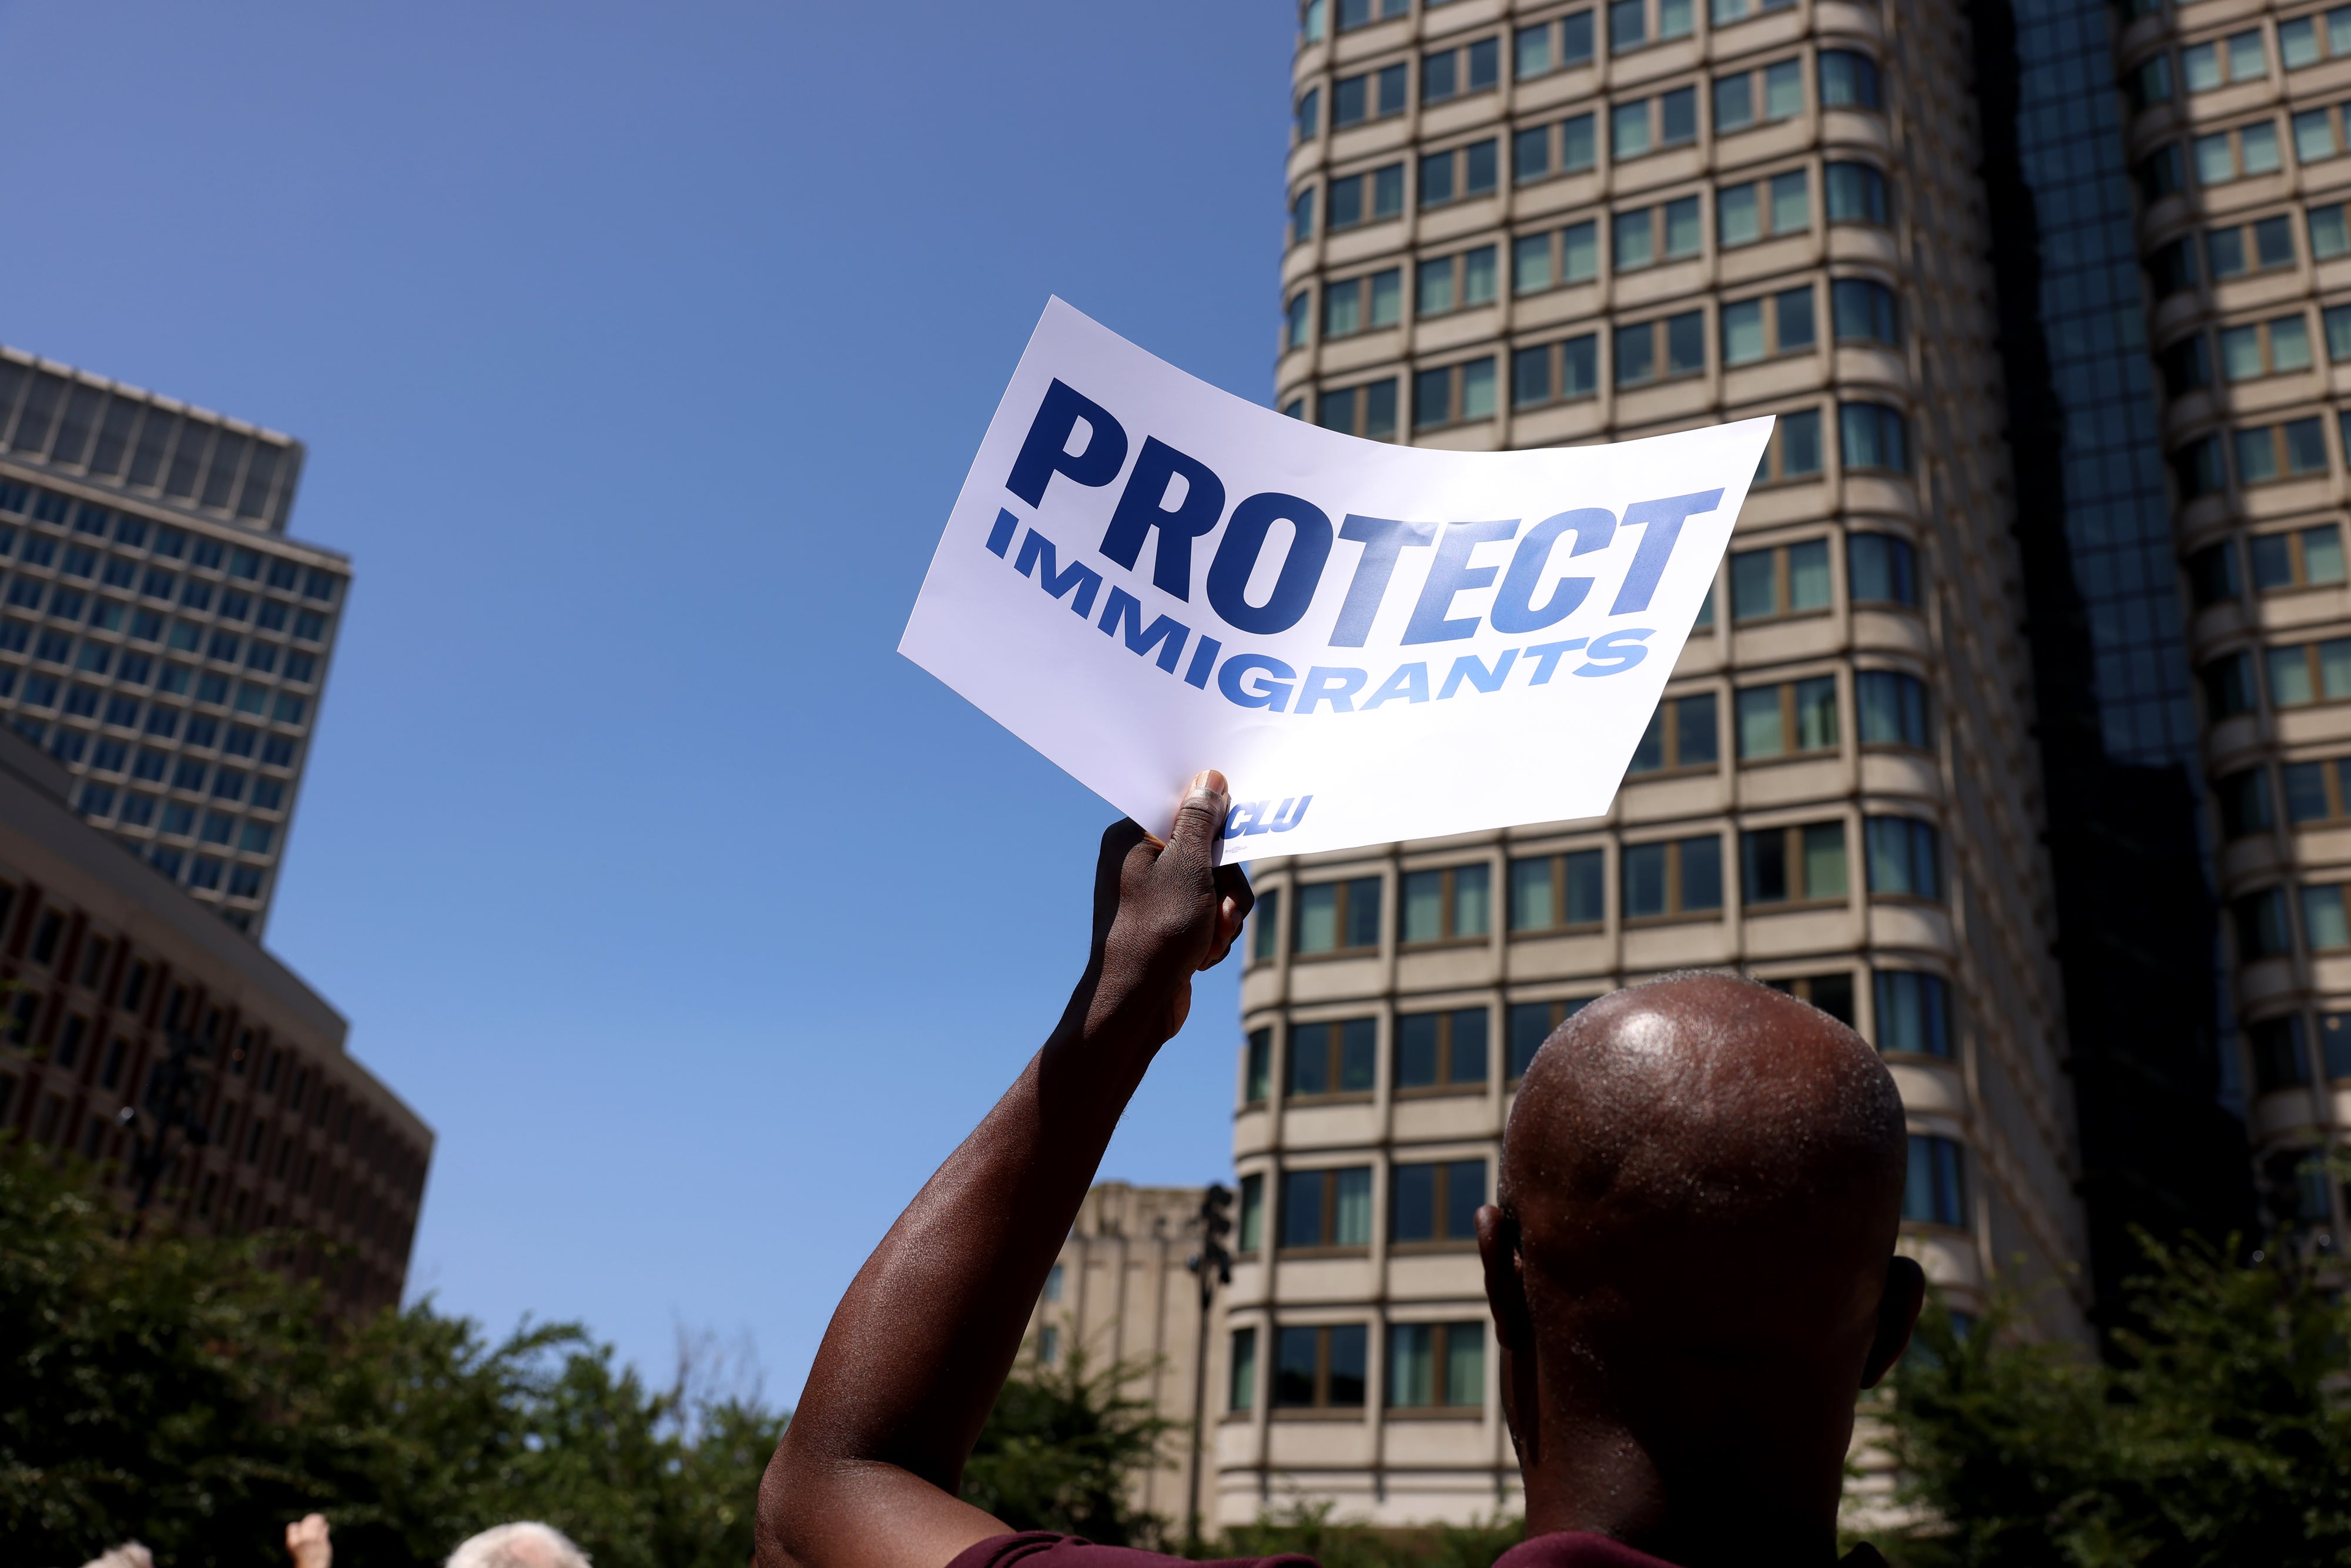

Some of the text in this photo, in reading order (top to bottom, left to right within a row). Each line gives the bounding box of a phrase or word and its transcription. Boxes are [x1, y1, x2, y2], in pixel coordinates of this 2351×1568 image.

[985, 508, 1657, 714] IMMIGRANTS
[1005, 377, 1726, 648] PROTECT
[1214, 795, 1314, 841] CLU
